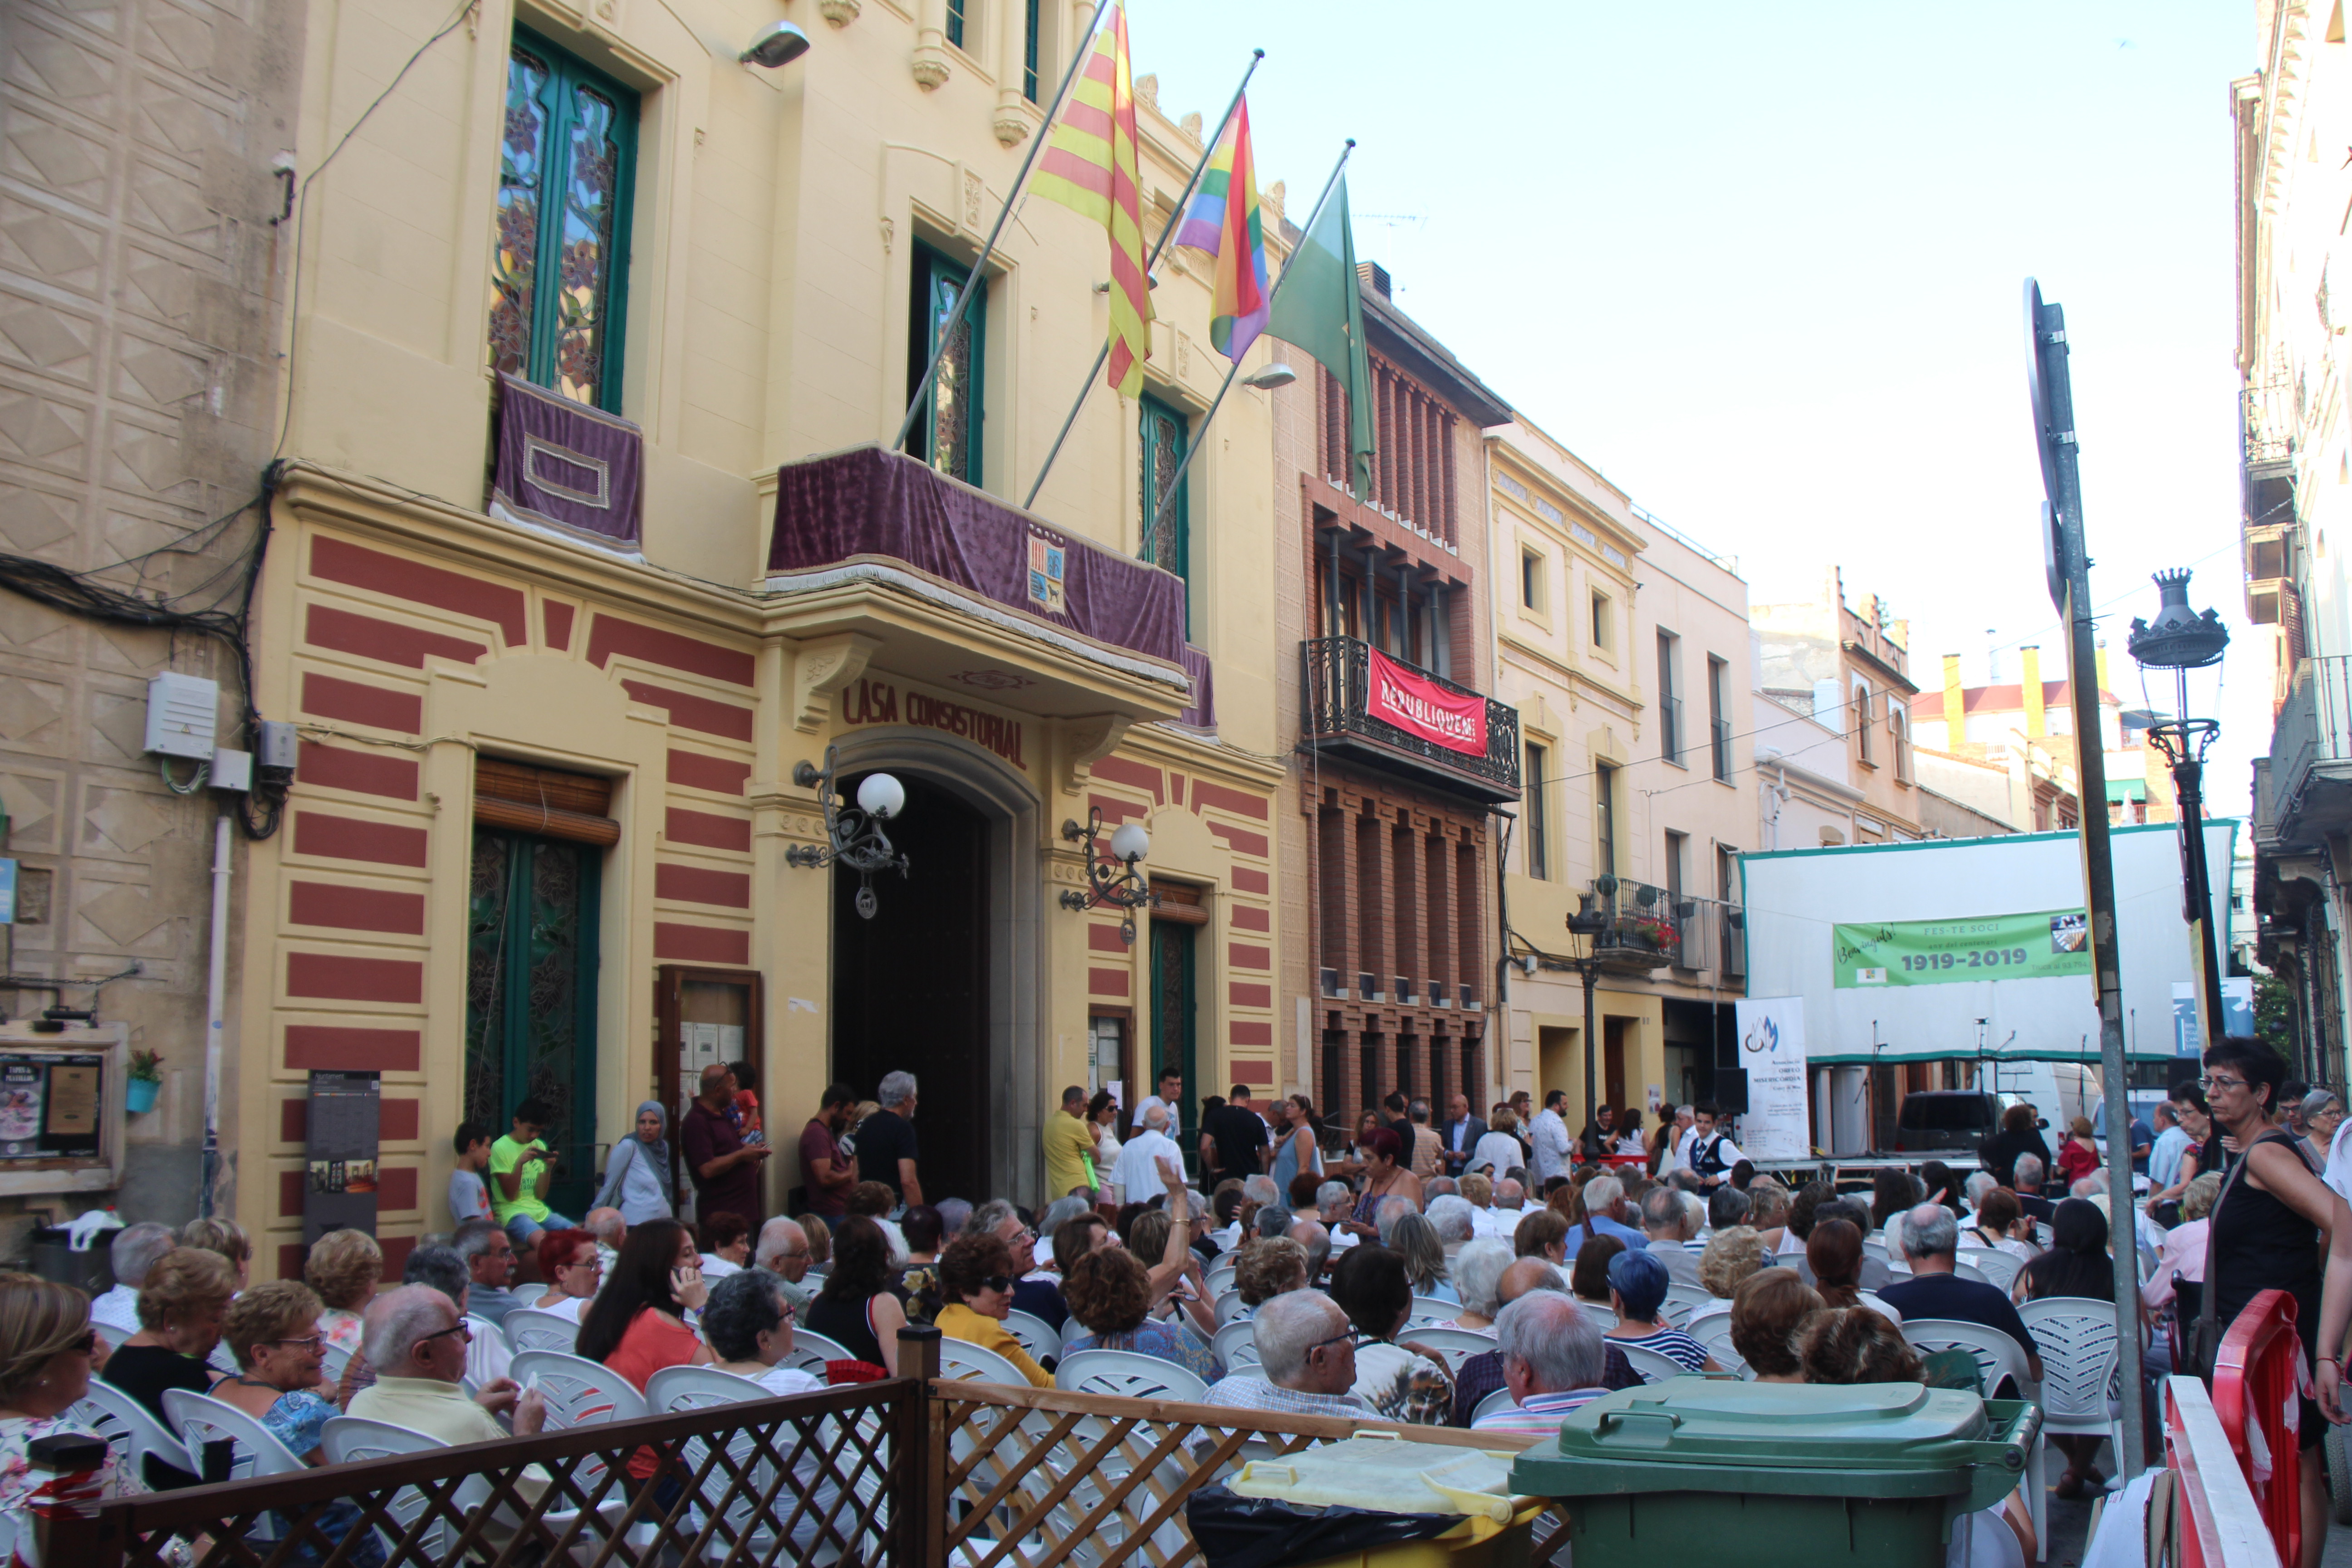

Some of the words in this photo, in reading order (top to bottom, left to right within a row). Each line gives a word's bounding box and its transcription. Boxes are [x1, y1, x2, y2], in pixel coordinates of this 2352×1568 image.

[1381, 679, 1473, 736] REPUBLIQUEM
[843, 678, 898, 725] CASA
[906, 691, 1027, 771] CONSISTORIAL
[1924, 926, 1965, 935] FES-TE
[1970, 923, 1999, 932] SOCI
[1960, 939, 1997, 947] centenari
[1901, 947, 2027, 971] 1919-2019
